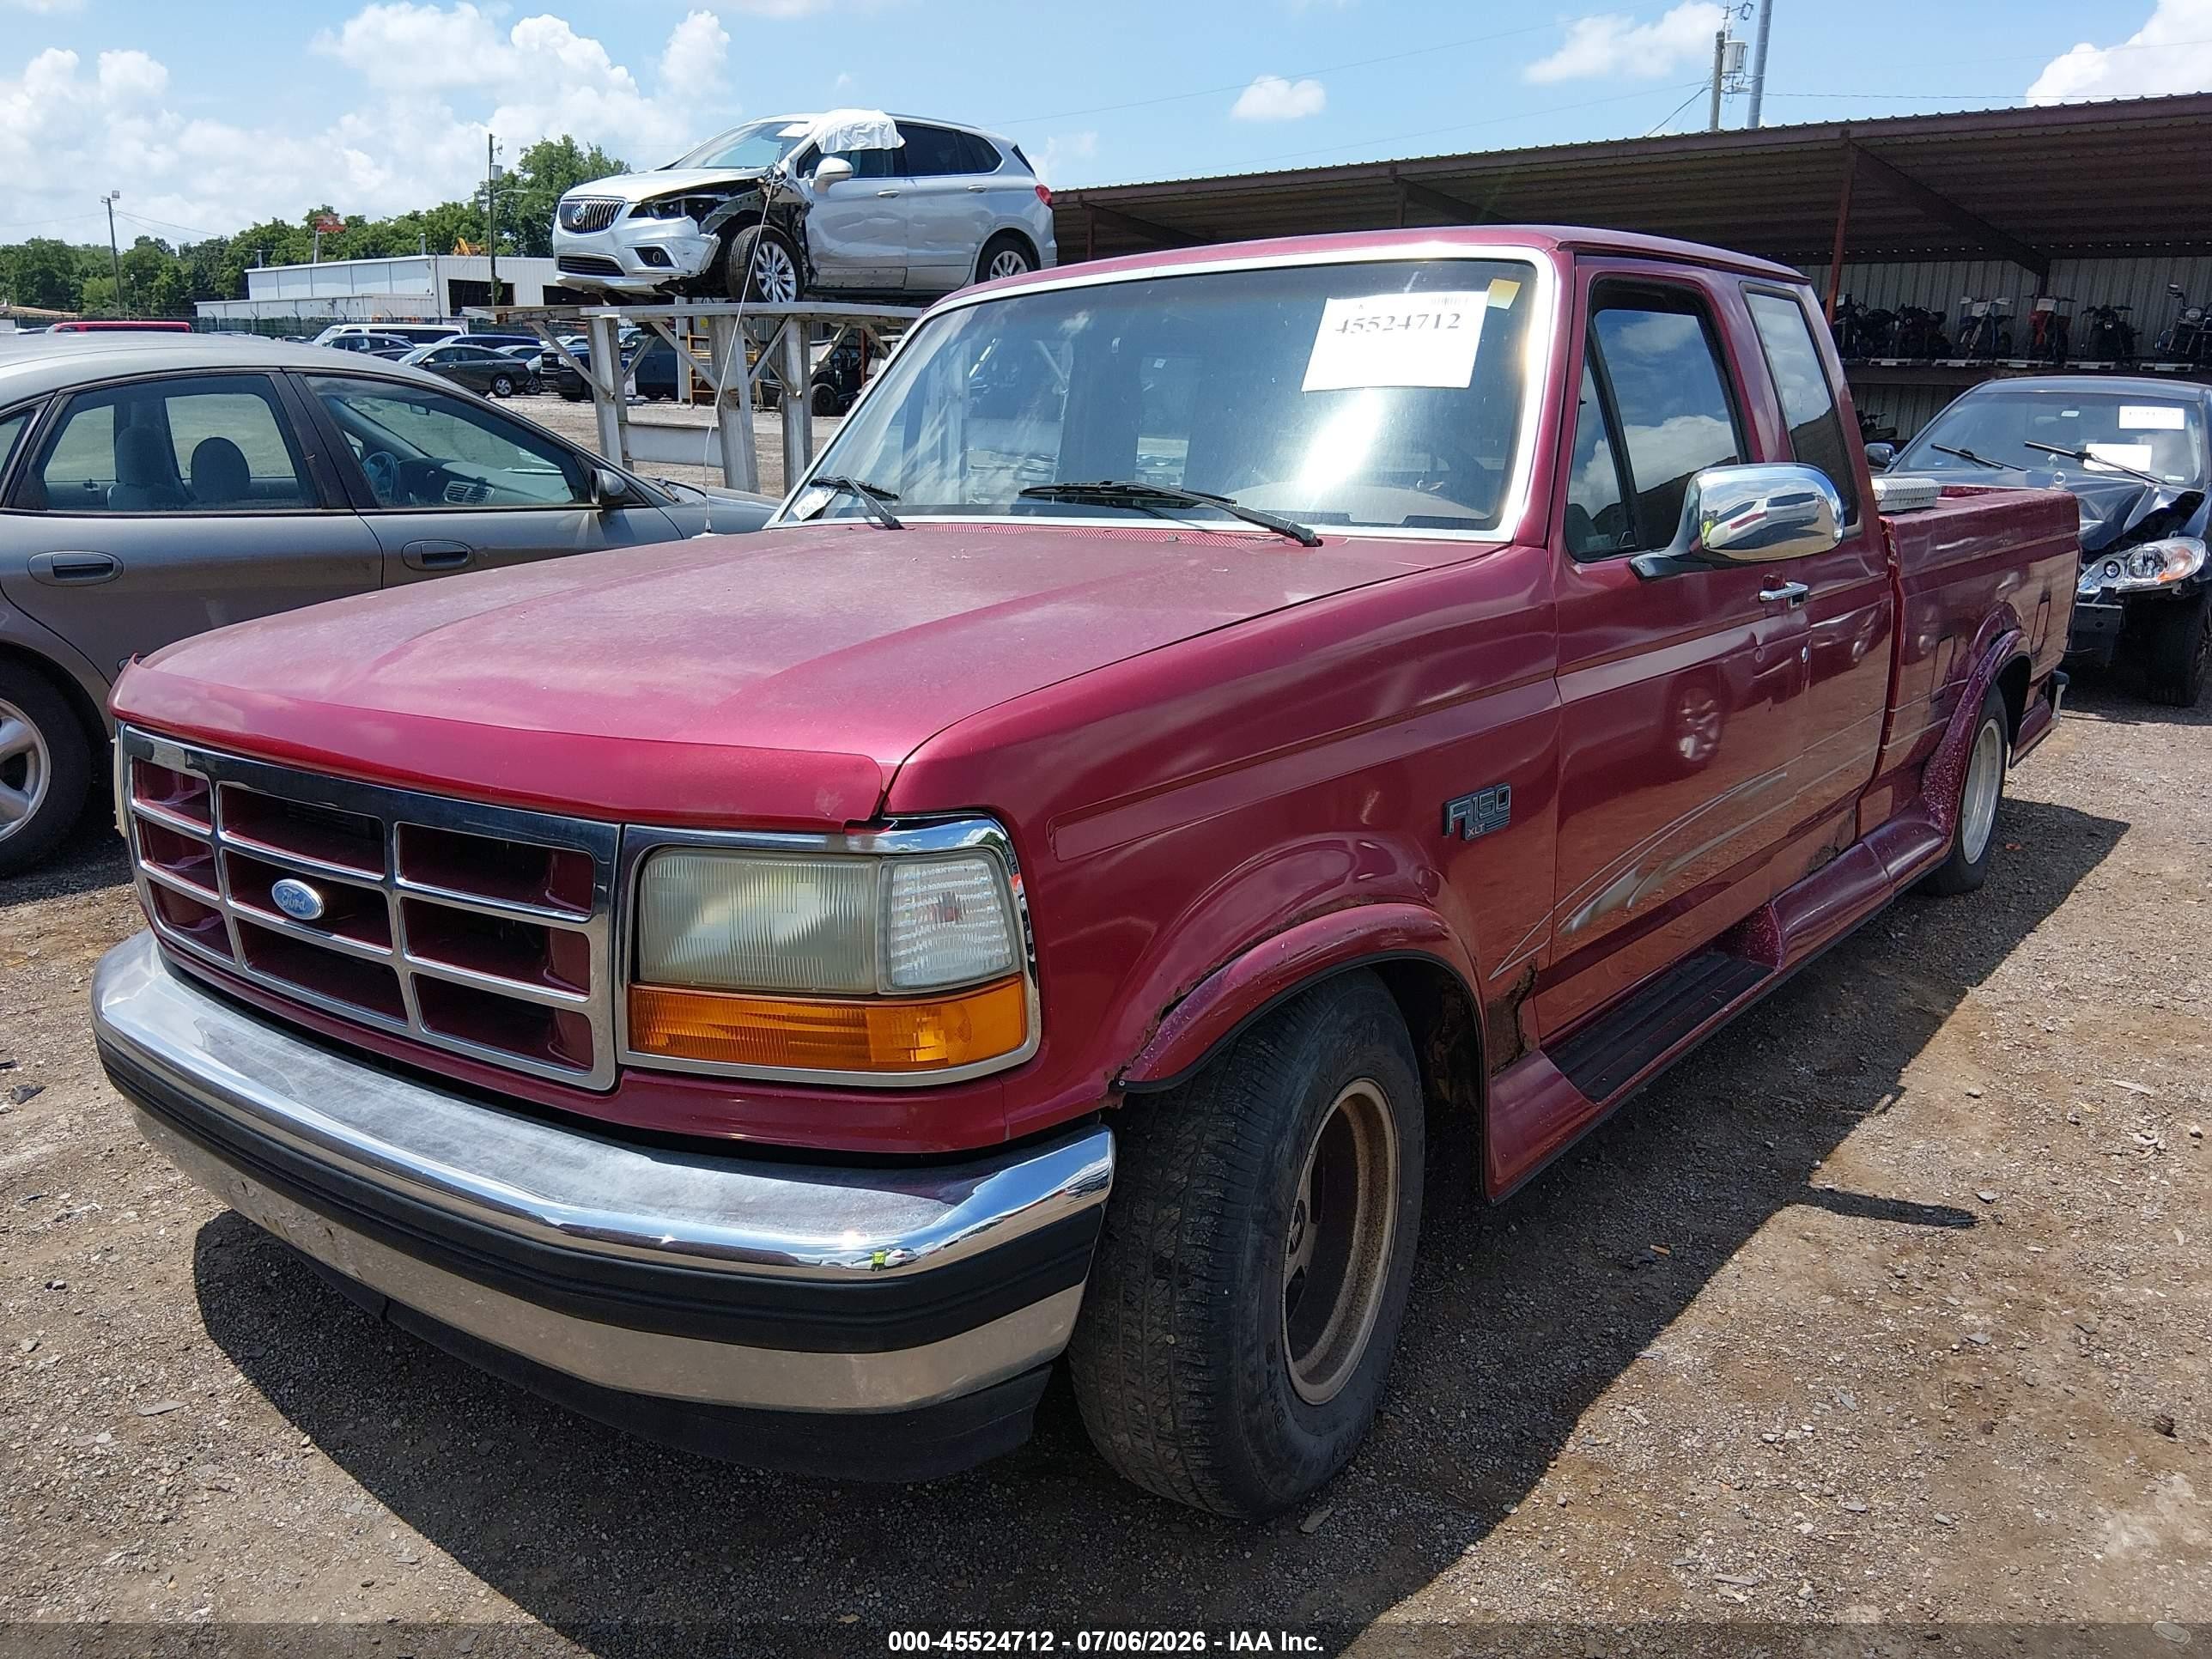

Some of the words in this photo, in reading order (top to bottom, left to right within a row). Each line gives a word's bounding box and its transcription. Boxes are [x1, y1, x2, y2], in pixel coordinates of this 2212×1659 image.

[1335, 313, 1462, 334] 45524712
[1467, 823, 1485, 838] XLT
[282, 887, 307, 911] Ford
